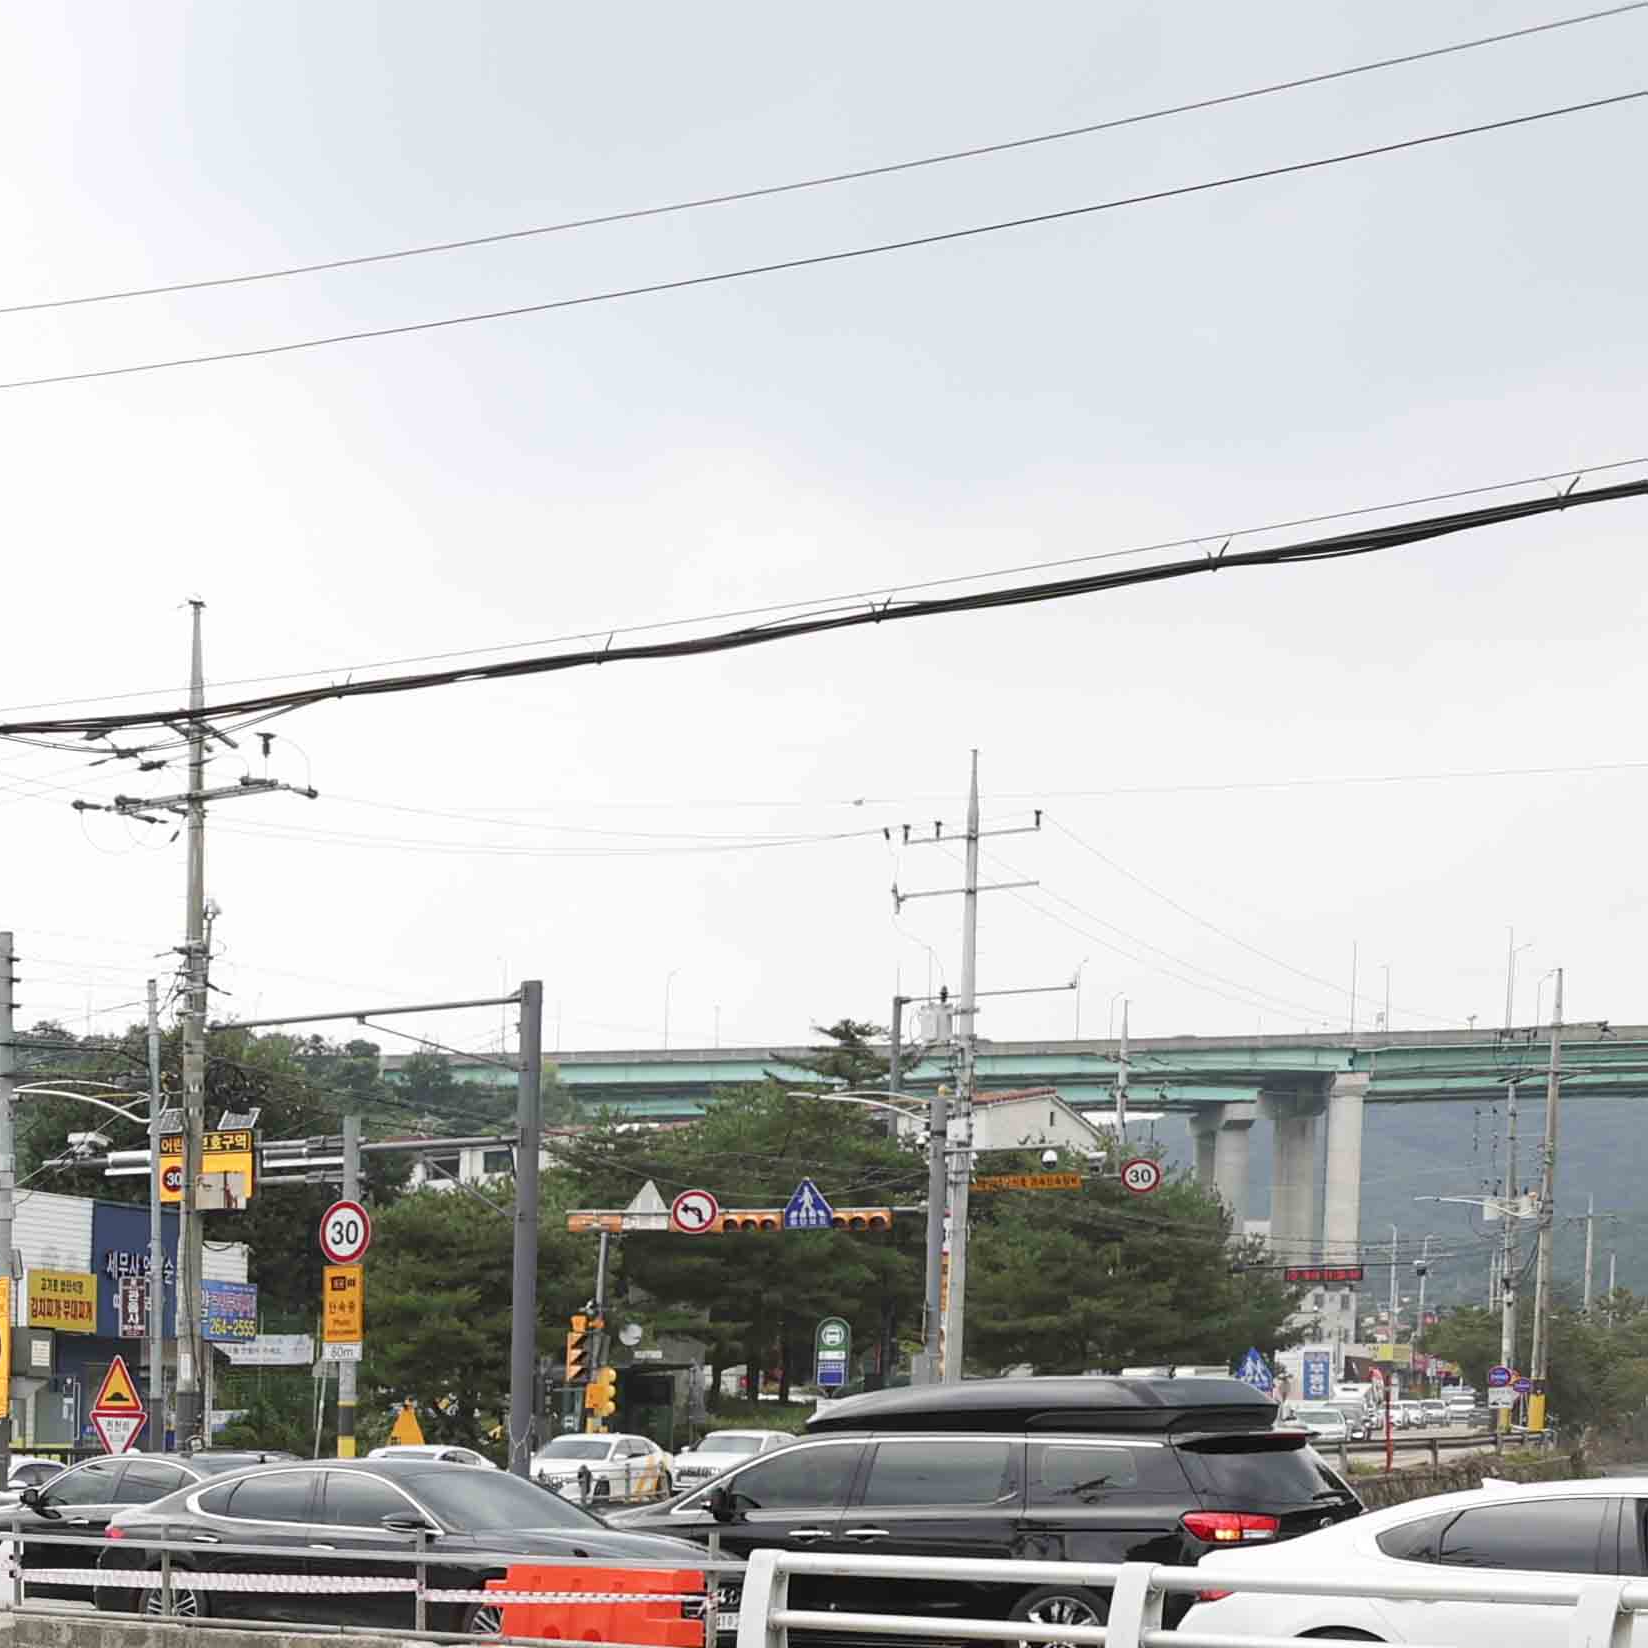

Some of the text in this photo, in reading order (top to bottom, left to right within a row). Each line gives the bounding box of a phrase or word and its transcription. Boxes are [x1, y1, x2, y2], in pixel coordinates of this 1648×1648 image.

[160, 1136, 184, 1153] 어린
[1129, 1168, 1152, 1183] 30
[331, 1220, 359, 1246] 30
[106, 1251, 140, 1280] 세무사
